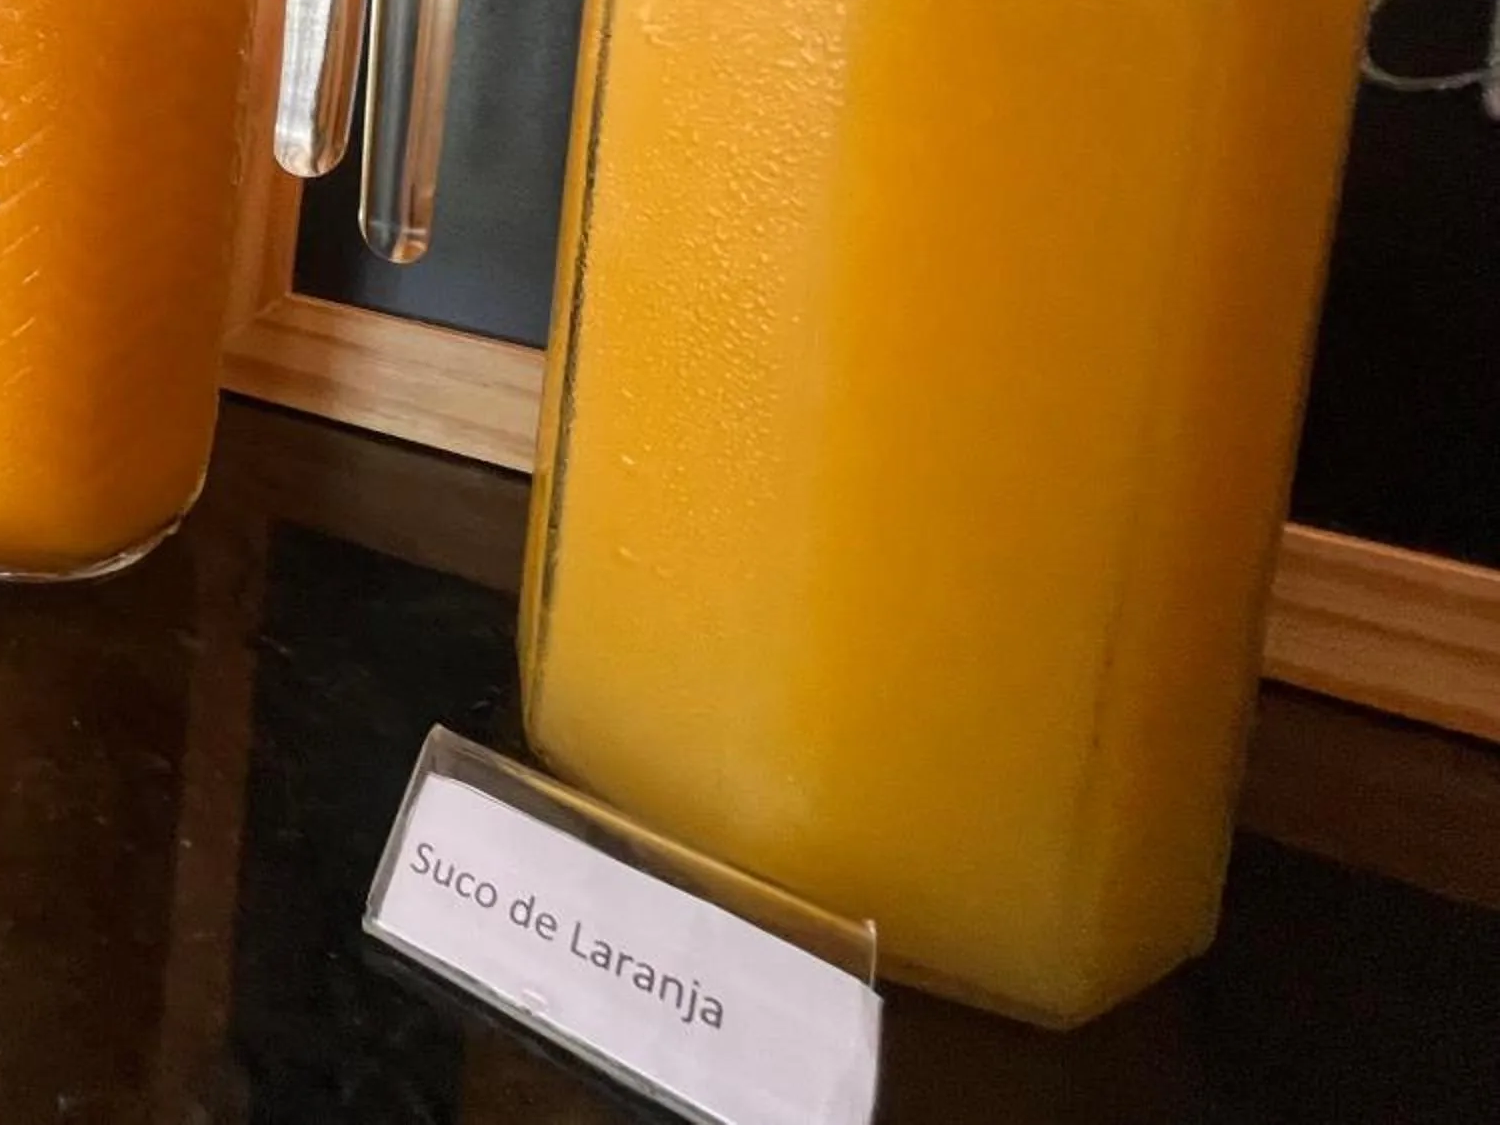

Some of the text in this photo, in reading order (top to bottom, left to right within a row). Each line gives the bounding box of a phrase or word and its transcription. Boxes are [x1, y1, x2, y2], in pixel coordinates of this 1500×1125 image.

[409, 842, 726, 1030] Suco de Laranja
